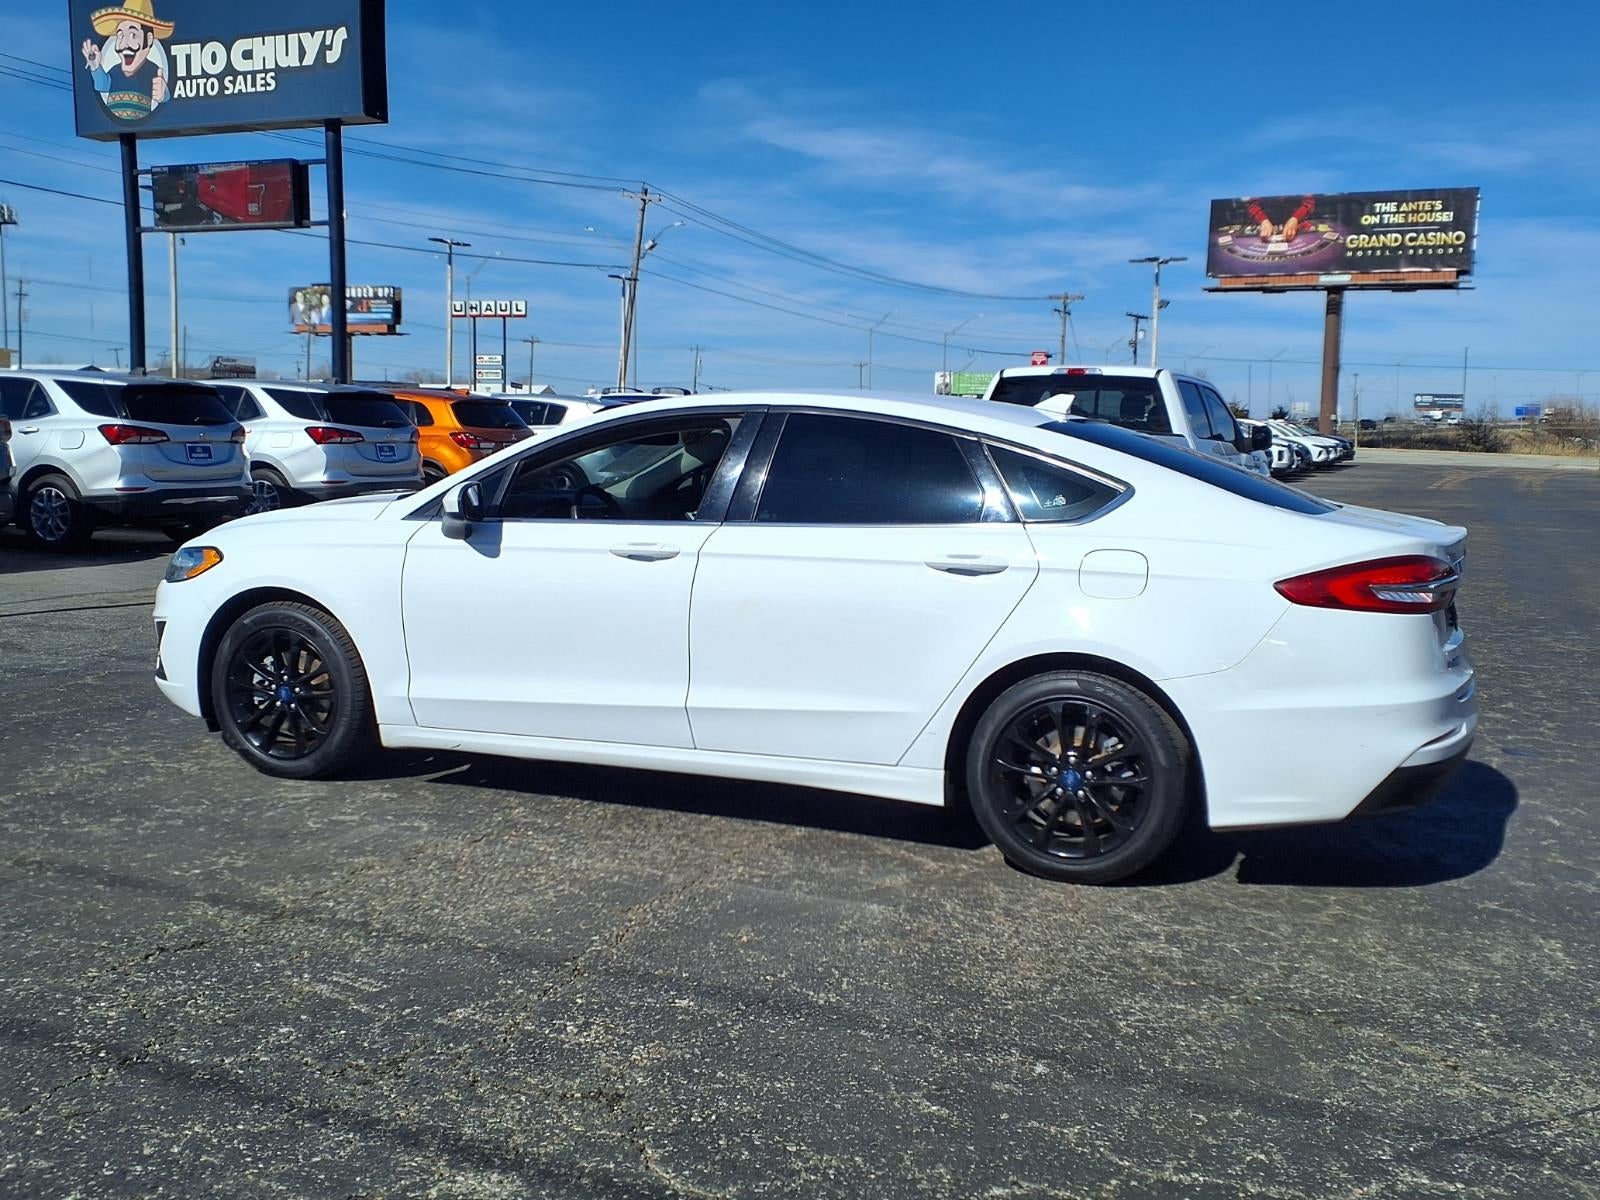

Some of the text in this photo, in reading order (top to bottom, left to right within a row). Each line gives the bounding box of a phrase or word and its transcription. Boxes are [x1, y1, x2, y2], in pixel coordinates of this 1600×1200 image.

[171, 26, 348, 77] TIO CHUY'S
[173, 71, 276, 99] AUTO SALES
[1374, 200, 1443, 212] THE ANTE'S
[1361, 211, 1454, 225] ON THE HOUSE!
[1346, 230, 1466, 248] GRAND CASINO
[1346, 247, 1464, 257] HOTEL RESORT
